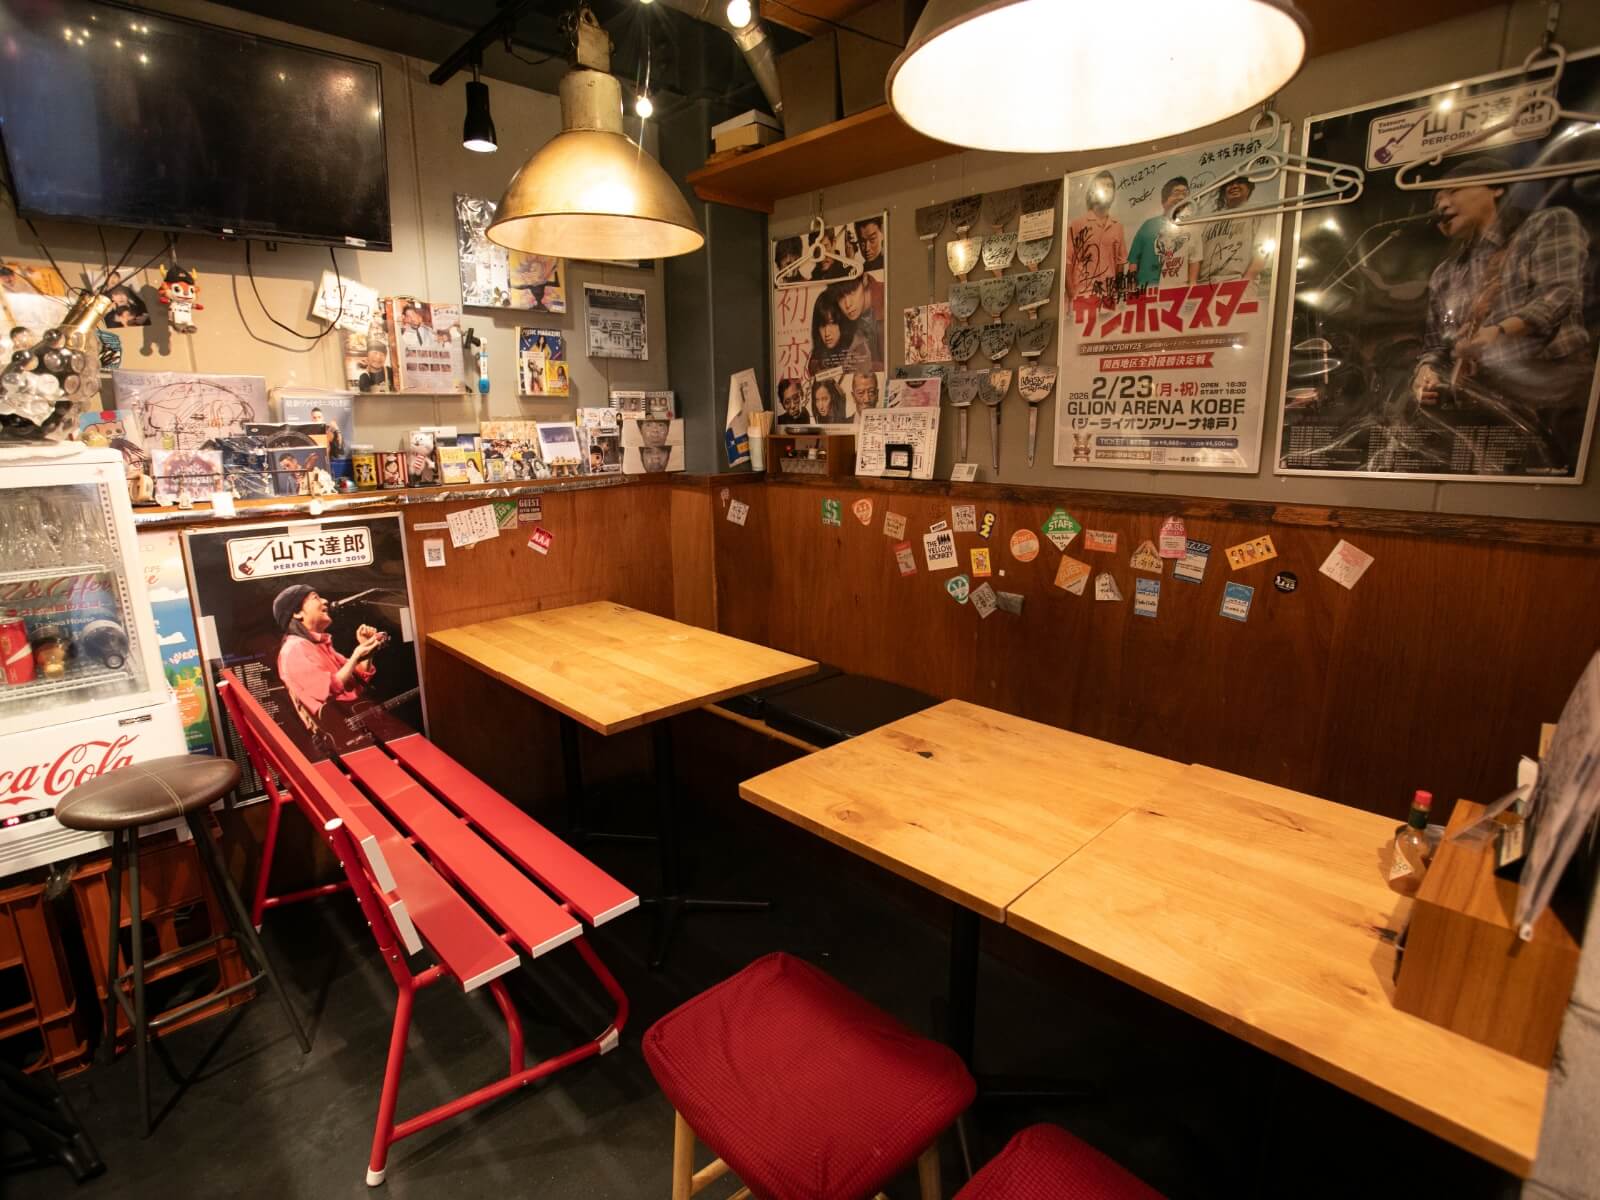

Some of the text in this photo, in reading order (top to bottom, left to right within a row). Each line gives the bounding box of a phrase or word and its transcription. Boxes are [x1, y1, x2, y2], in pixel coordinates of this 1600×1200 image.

[1073, 280, 1259, 337] サンボマスター
[1102, 353, 1208, 370] 関西地区全員優勝決定戦
[1069, 392, 1089, 400] 2026
[1091, 375, 1153, 400] 2/23
[1067, 398, 1246, 416] GLION ARENA KOBE
[1071, 417, 1238, 431] (ジーライオンアリーナ神戸)
[518, 498, 540, 508] GUEST
[1048, 519, 1074, 531] STAFF
[271, 533, 366, 562] 山下達郎
[928, 545, 953, 554] YELLOW
[273, 554, 367, 571] PERFORMANCE 2019
[928, 552, 953, 561] MONKEY
